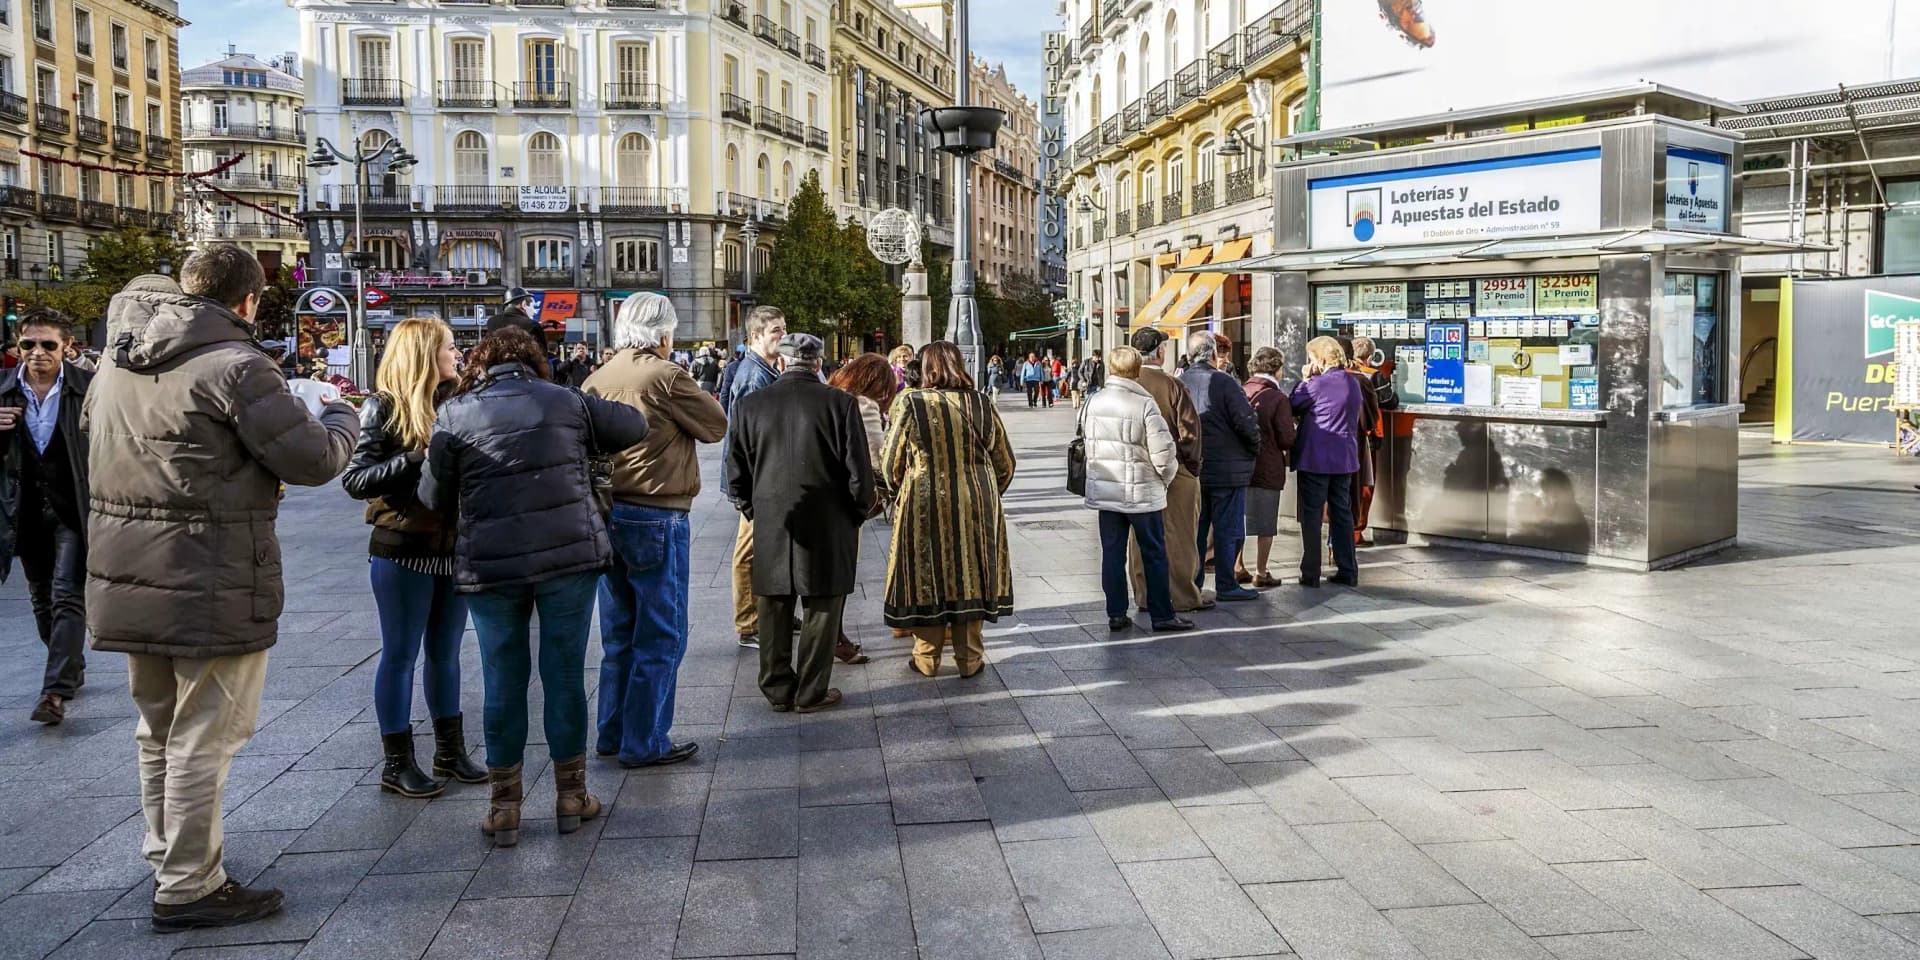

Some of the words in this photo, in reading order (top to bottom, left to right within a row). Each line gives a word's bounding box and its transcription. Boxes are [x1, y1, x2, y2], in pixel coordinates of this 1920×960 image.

[1045, 32, 1060, 114] HOTEL
[1044, 126, 1060, 238] MODERNO
[521, 185, 531, 194] SE
[535, 185, 567, 194] ALQUILA
[1391, 184, 1454, 205] Loterías
[1459, 186, 1469, 203] y
[521, 201, 529, 209] 91
[531, 201, 546, 209] 436
[548, 201, 557, 209] 27
[559, 201, 568, 209] 27
[1695, 196, 1718, 210] Apuestas
[1391, 206, 1464, 227] Apuestas
[1468, 201, 1493, 218] del
[1498, 195, 1560, 215] Estado
[1456, 226, 1465, 236] de
[1466, 226, 1479, 235] Oro
[1486, 223, 1540, 233] Administración
[1550, 220, 1560, 229] 59
[1483, 278, 1526, 291] 29914
[1541, 274, 1591, 288] 32304
[1374, 285, 1401, 294] 37368
[1495, 291, 1525, 300] Premio
[1554, 288, 1589, 298] Premio
[1825, 391, 1896, 412] Puert
